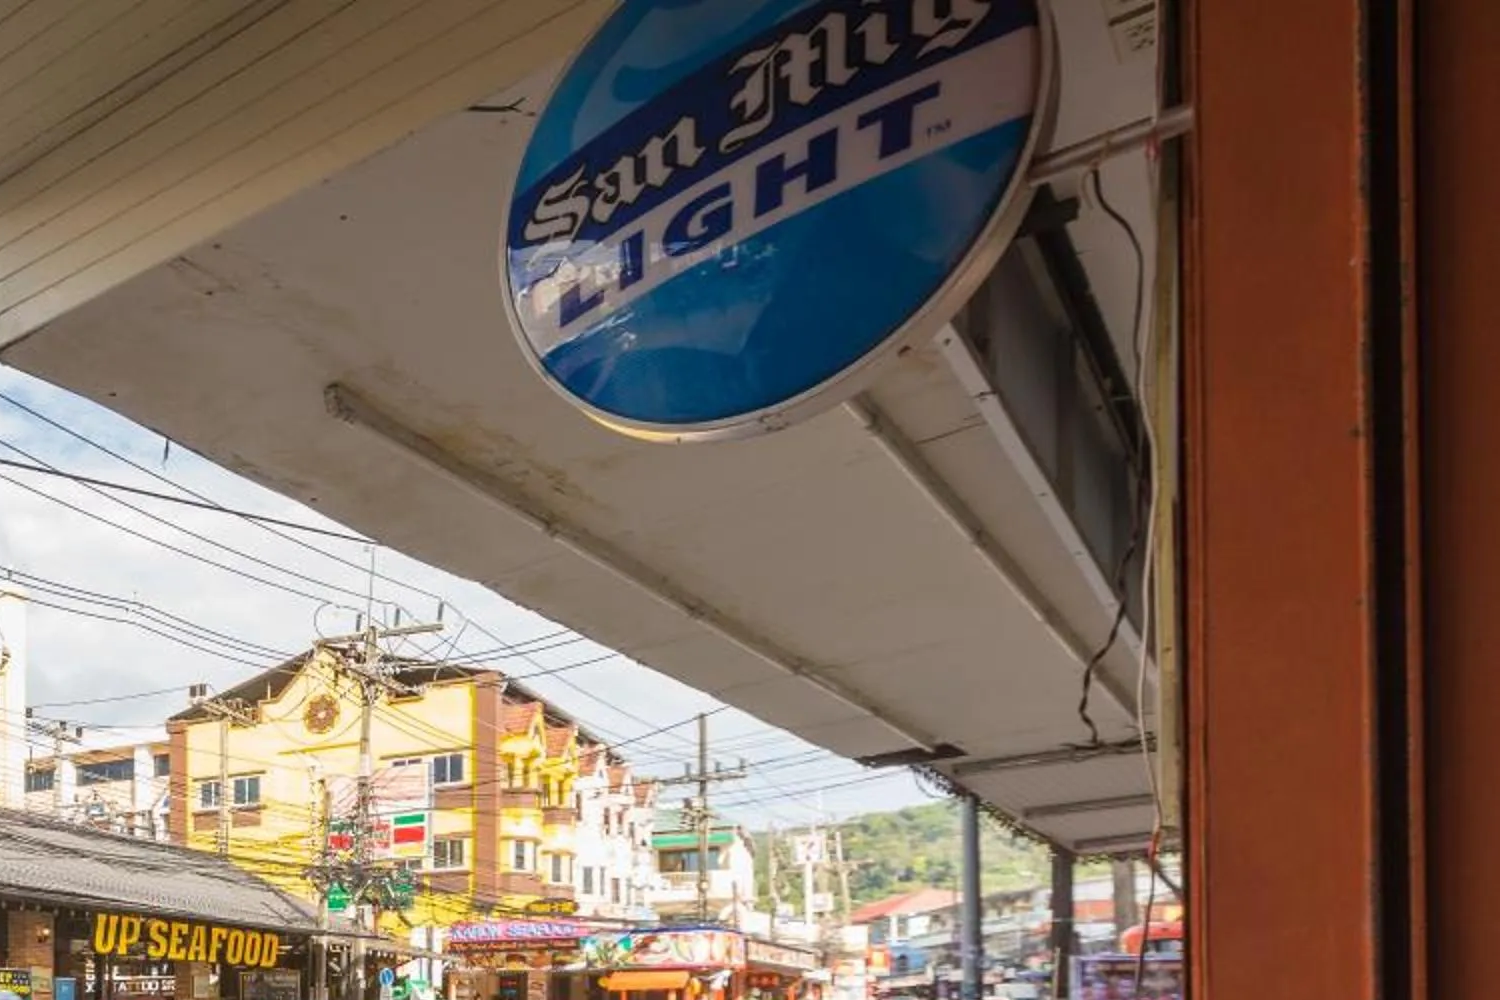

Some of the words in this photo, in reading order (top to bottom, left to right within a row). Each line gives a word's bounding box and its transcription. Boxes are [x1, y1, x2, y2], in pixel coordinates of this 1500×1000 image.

[523, 115, 706, 243] San
[559, 80, 941, 328] LIGHT
[94, 913, 142, 956] UP
[147, 917, 280, 968] SEAFOOD
